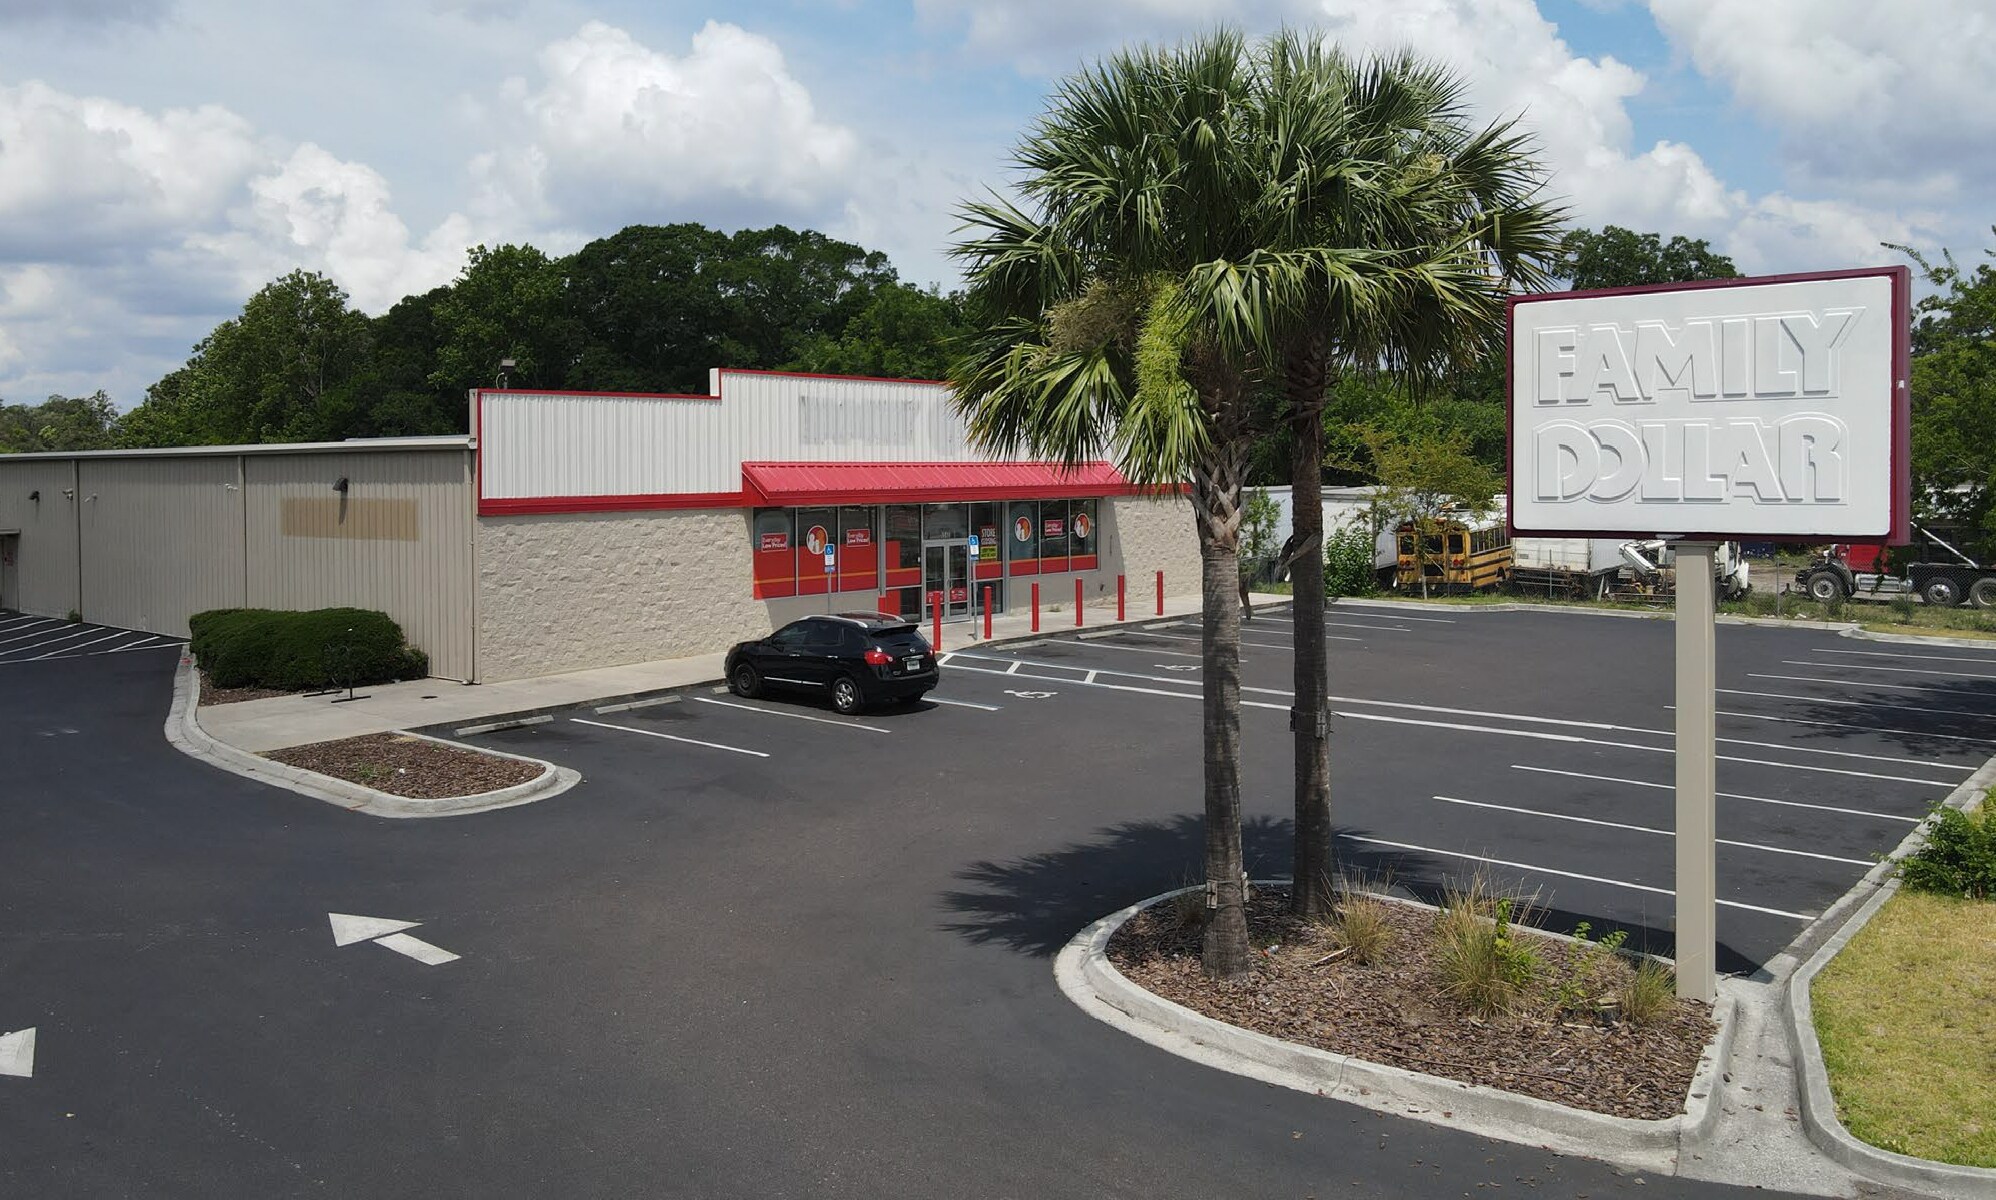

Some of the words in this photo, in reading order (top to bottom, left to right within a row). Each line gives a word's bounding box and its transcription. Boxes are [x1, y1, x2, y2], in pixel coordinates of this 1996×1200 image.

[1533, 307, 1866, 407] FAMILY
[1533, 412, 1849, 505] DOLLAR
[981, 528, 996, 537] STORE
